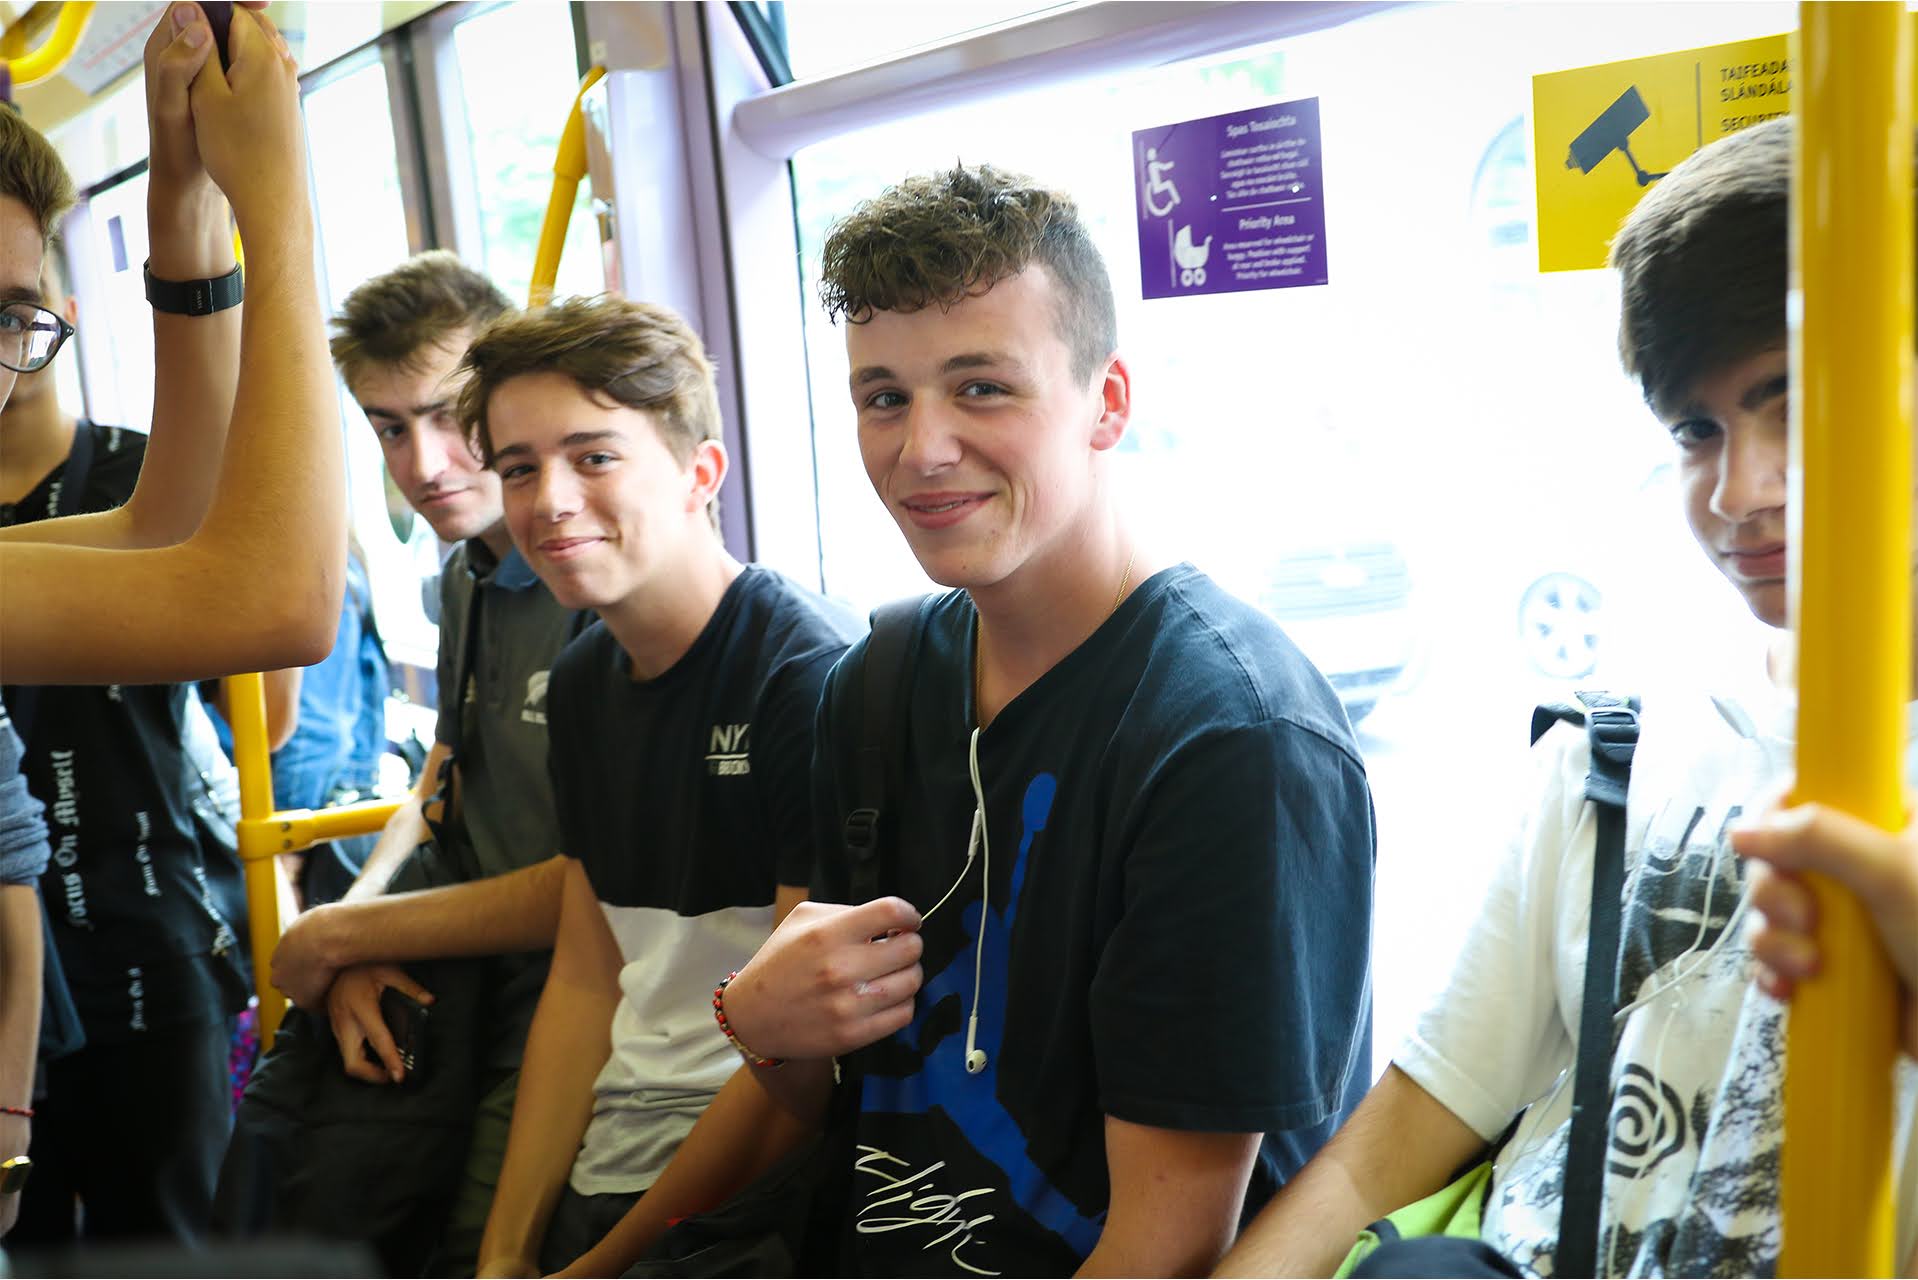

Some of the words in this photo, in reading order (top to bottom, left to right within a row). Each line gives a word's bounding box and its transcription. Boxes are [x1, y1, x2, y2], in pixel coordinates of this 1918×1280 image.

[1239, 216, 1271, 231] Priority
[1272, 214, 1296, 226] Area
[50, 749, 81, 827] Myself
[54, 834, 78, 867] On
